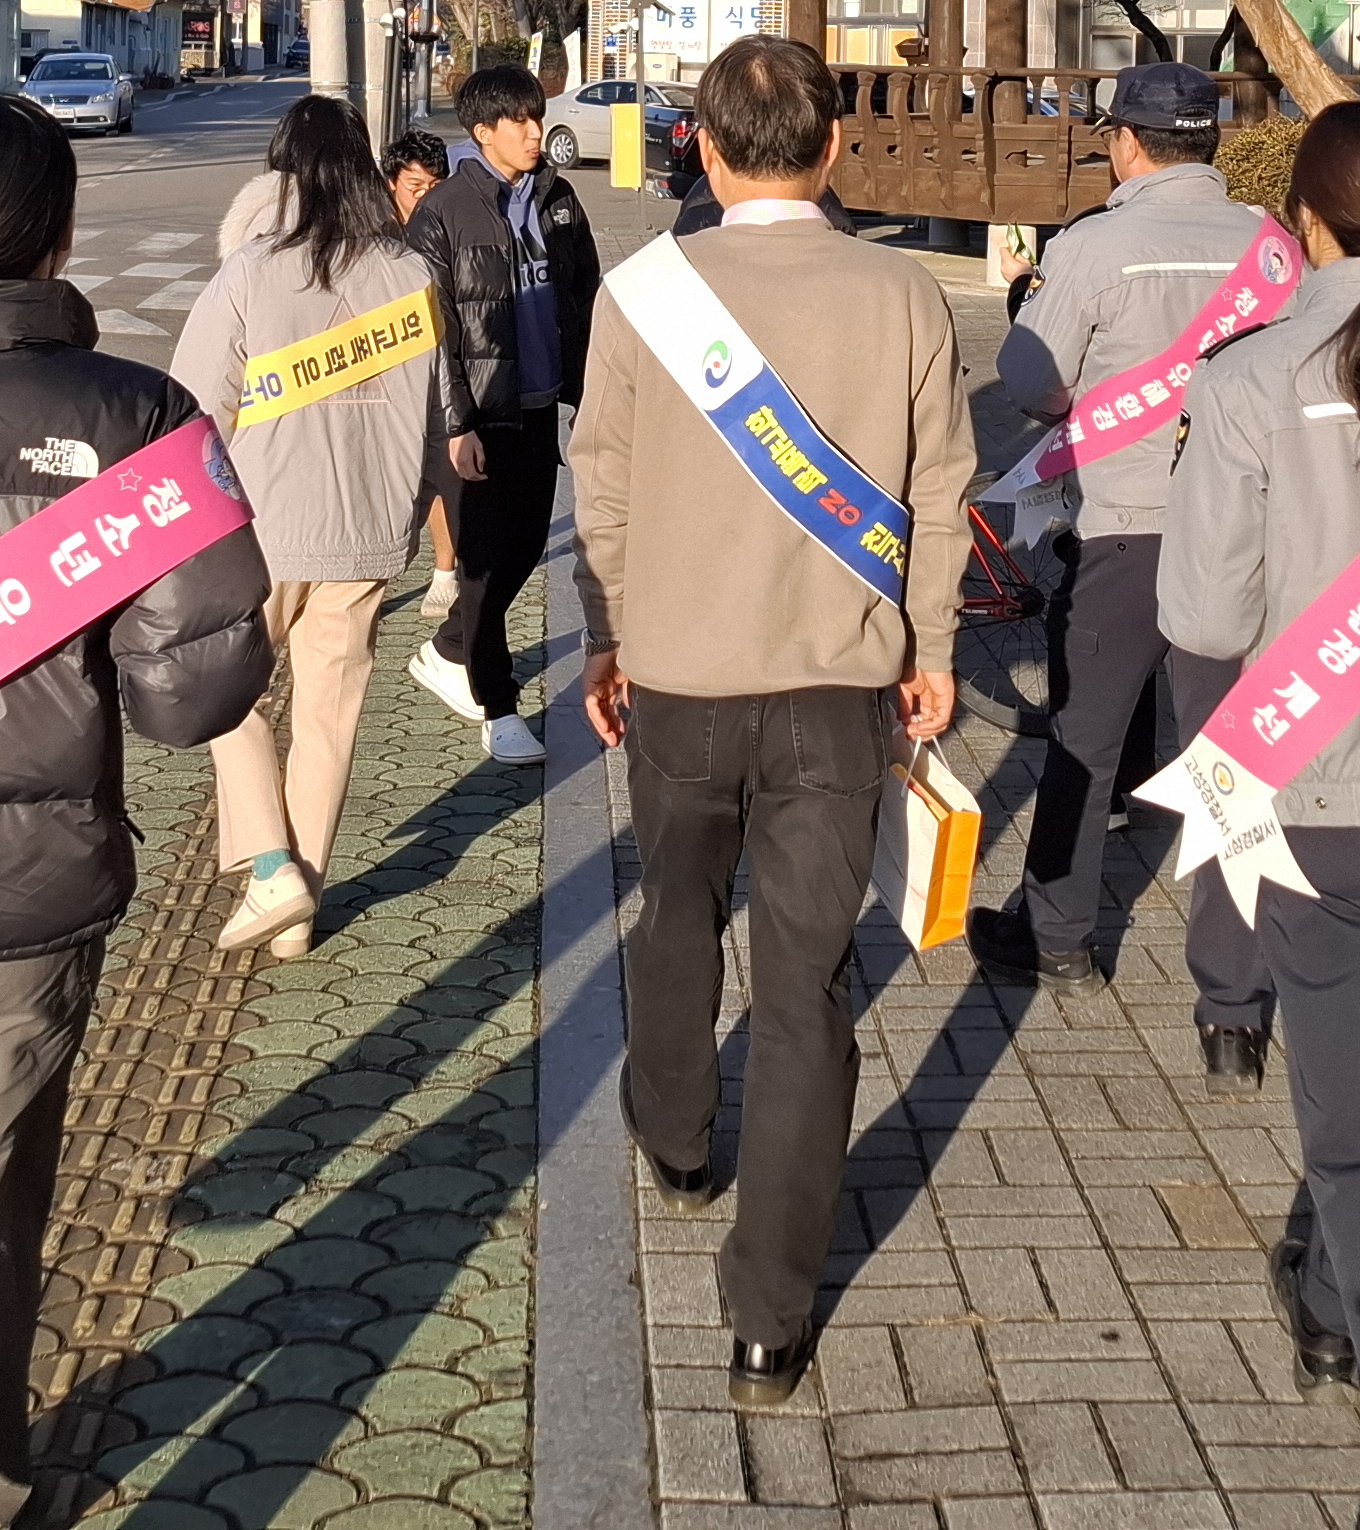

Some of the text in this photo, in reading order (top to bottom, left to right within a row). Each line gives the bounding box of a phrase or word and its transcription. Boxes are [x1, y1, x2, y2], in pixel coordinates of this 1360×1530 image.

[1175, 119, 1212, 128] POLICE
[291, 310, 424, 389] 학교폭력은
[1091, 362, 1193, 431] 유해환경
[19, 447, 74, 464] NORTH
[31, 460, 72, 476] FACE
[45, 437, 76, 452] THE
[744, 405, 830, 495] 학교폭력
[49, 476, 192, 588] 청소년
[1251, 670, 1321, 746] 개선
[1184, 755, 1232, 836] 고성경찰서
